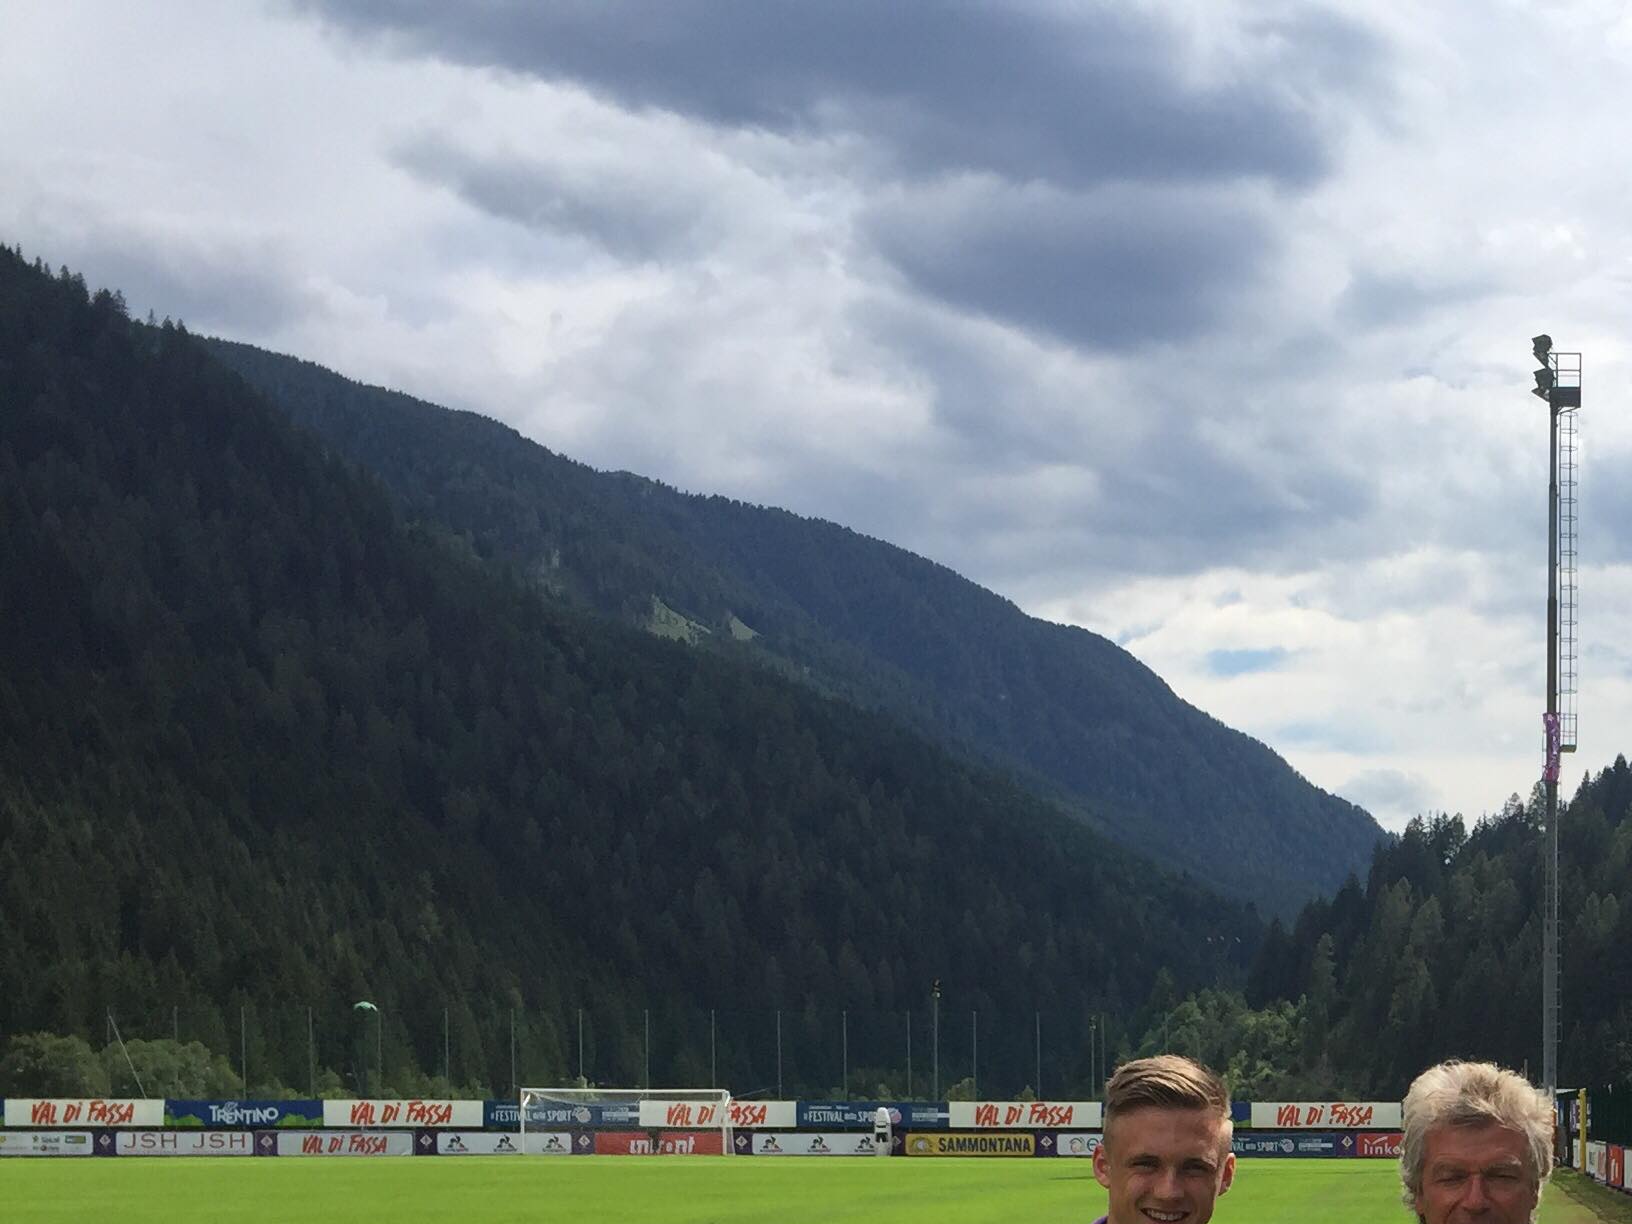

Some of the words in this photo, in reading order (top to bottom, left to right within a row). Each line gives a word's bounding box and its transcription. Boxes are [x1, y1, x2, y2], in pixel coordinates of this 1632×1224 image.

[32, 1101, 57, 1125] VAL
[88, 1100, 134, 1126] FASSA
[209, 1104, 278, 1124] TRENTINO
[350, 1102, 376, 1125] VAL
[406, 1100, 452, 1126] FASSA
[667, 1103, 692, 1126] VAL
[809, 1111, 844, 1122] FESTIVAL
[976, 1104, 1000, 1126] VAL
[1029, 1103, 1073, 1126] FASSA
[1277, 1105, 1301, 1126] VAL
[1329, 1104, 1373, 1126] FASSA
[124, 1134, 177, 1148] JSH
[193, 1134, 245, 1148] JSH
[303, 1135, 323, 1154] VAL
[348, 1135, 387, 1154] FASSA
[939, 1137, 1031, 1152] SAMMONTANA
